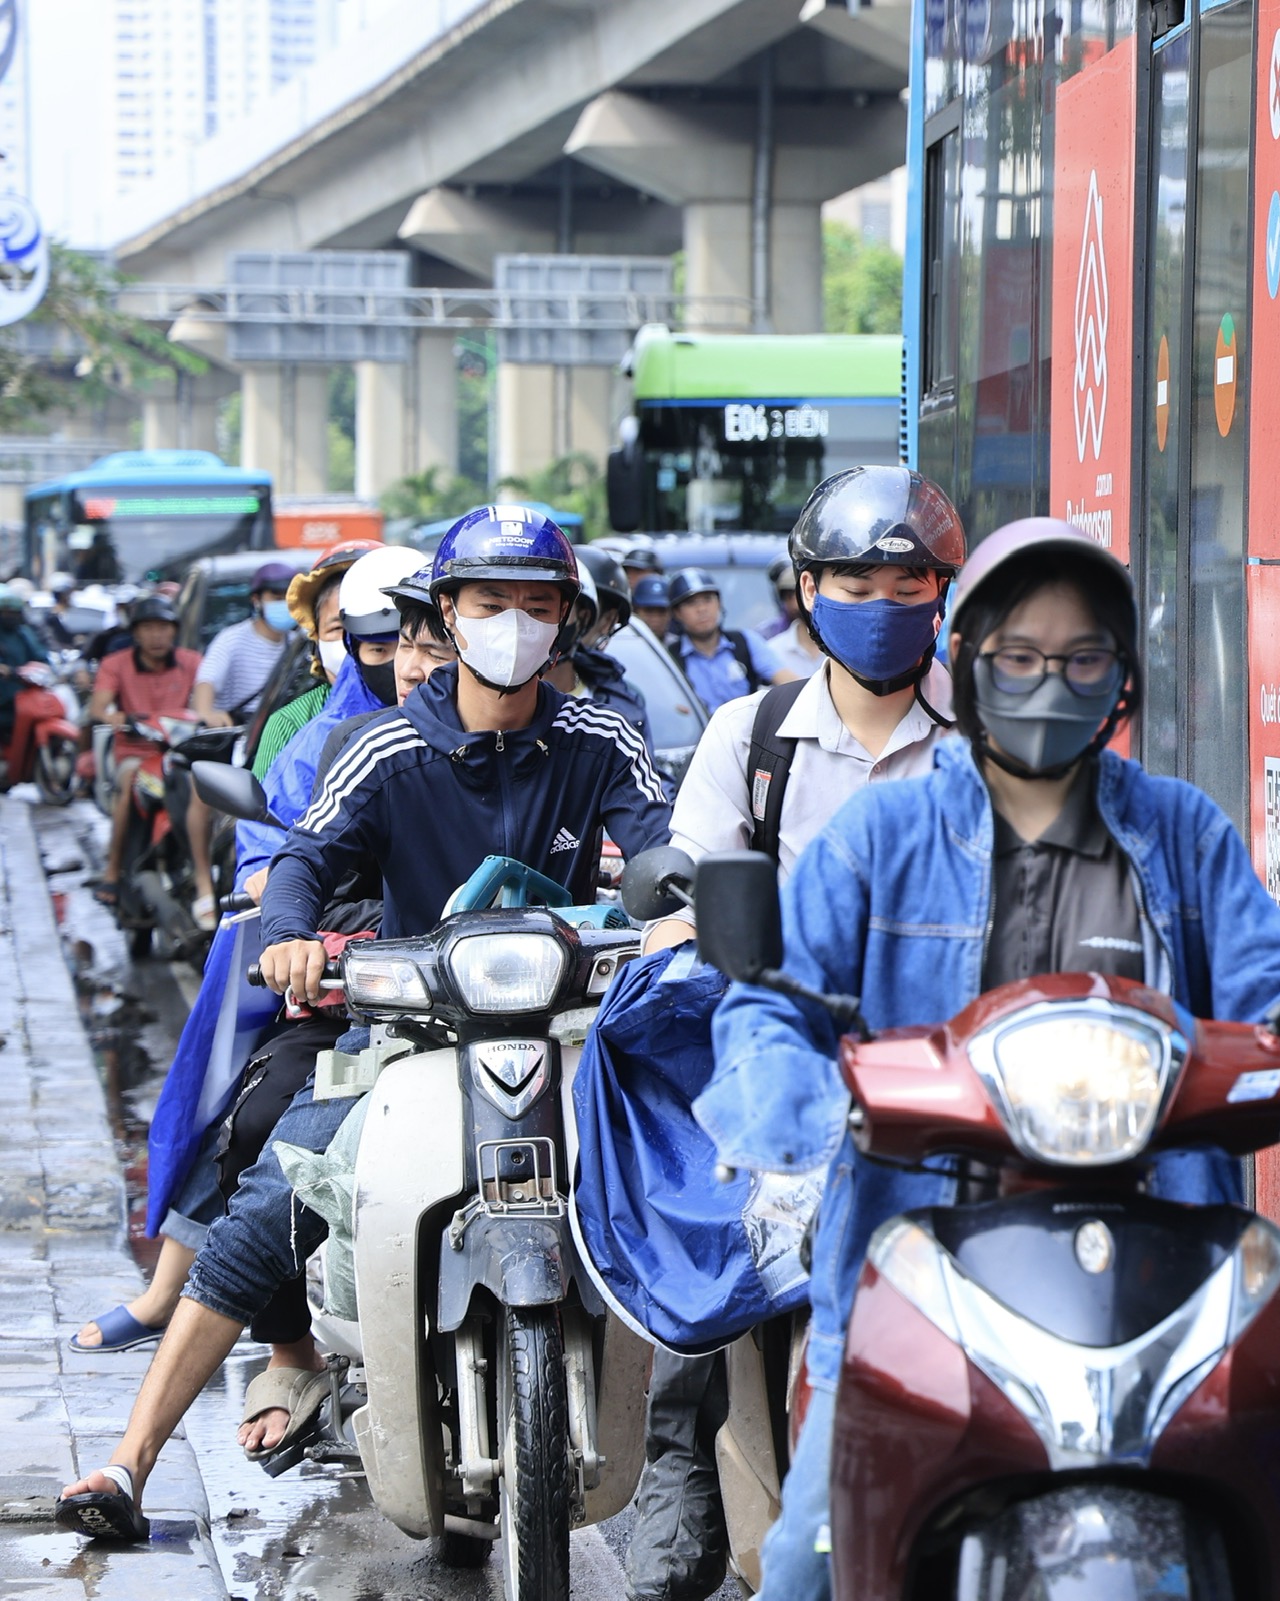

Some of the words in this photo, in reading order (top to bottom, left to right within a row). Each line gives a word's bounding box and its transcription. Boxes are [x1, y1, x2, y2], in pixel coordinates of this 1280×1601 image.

[725, 404, 769, 441] E04
[1260, 683, 1276, 727] Quét
[550, 840, 581, 855] adidas
[487, 1043, 538, 1054] HONDA
